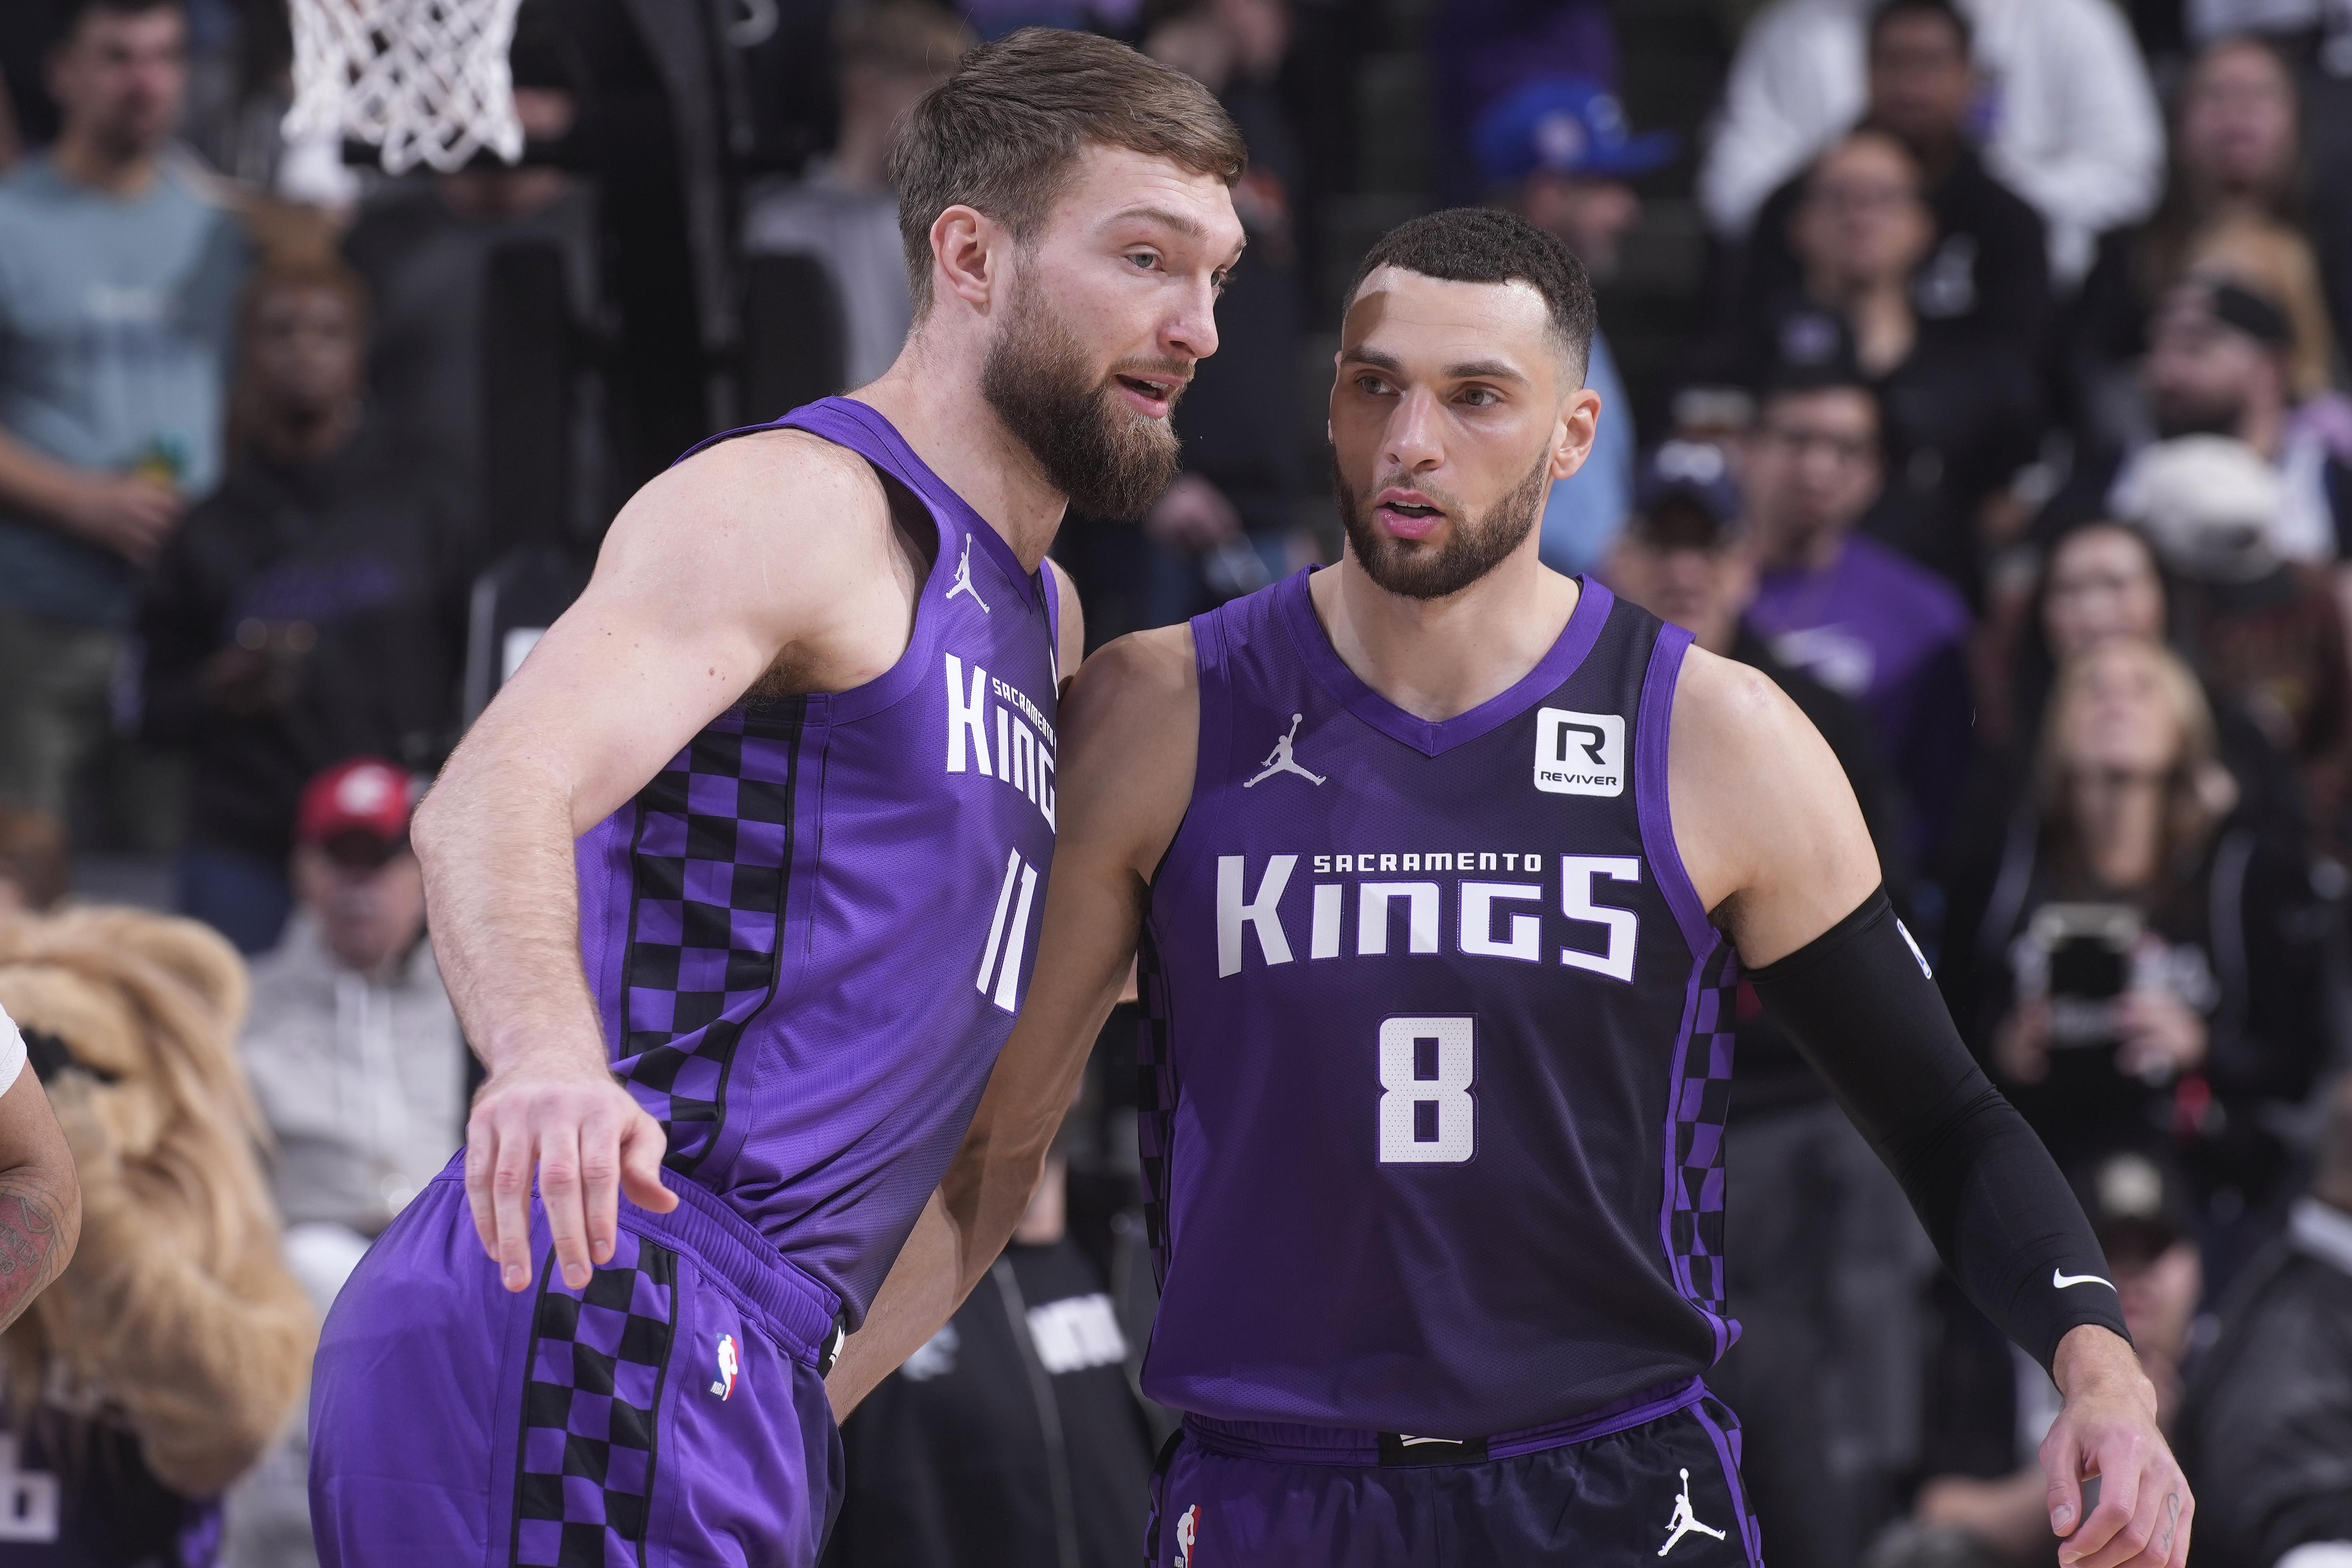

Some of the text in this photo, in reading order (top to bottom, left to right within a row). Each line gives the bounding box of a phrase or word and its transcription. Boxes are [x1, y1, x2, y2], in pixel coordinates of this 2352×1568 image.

[992, 677, 1054, 747] SACRAMENTO
[945, 652, 1057, 835] KING
[1556, 721, 1606, 764] R
[1541, 771, 1617, 786] REVIVER
[1314, 852, 1542, 873] SACRAMENTO
[976, 846, 1038, 1013] 11
[1216, 855, 1639, 982] KINGS
[1379, 1018, 1473, 1162] 8
[710, 1381, 726, 1396] NBA
[1174, 1555, 1184, 1568] NBA
